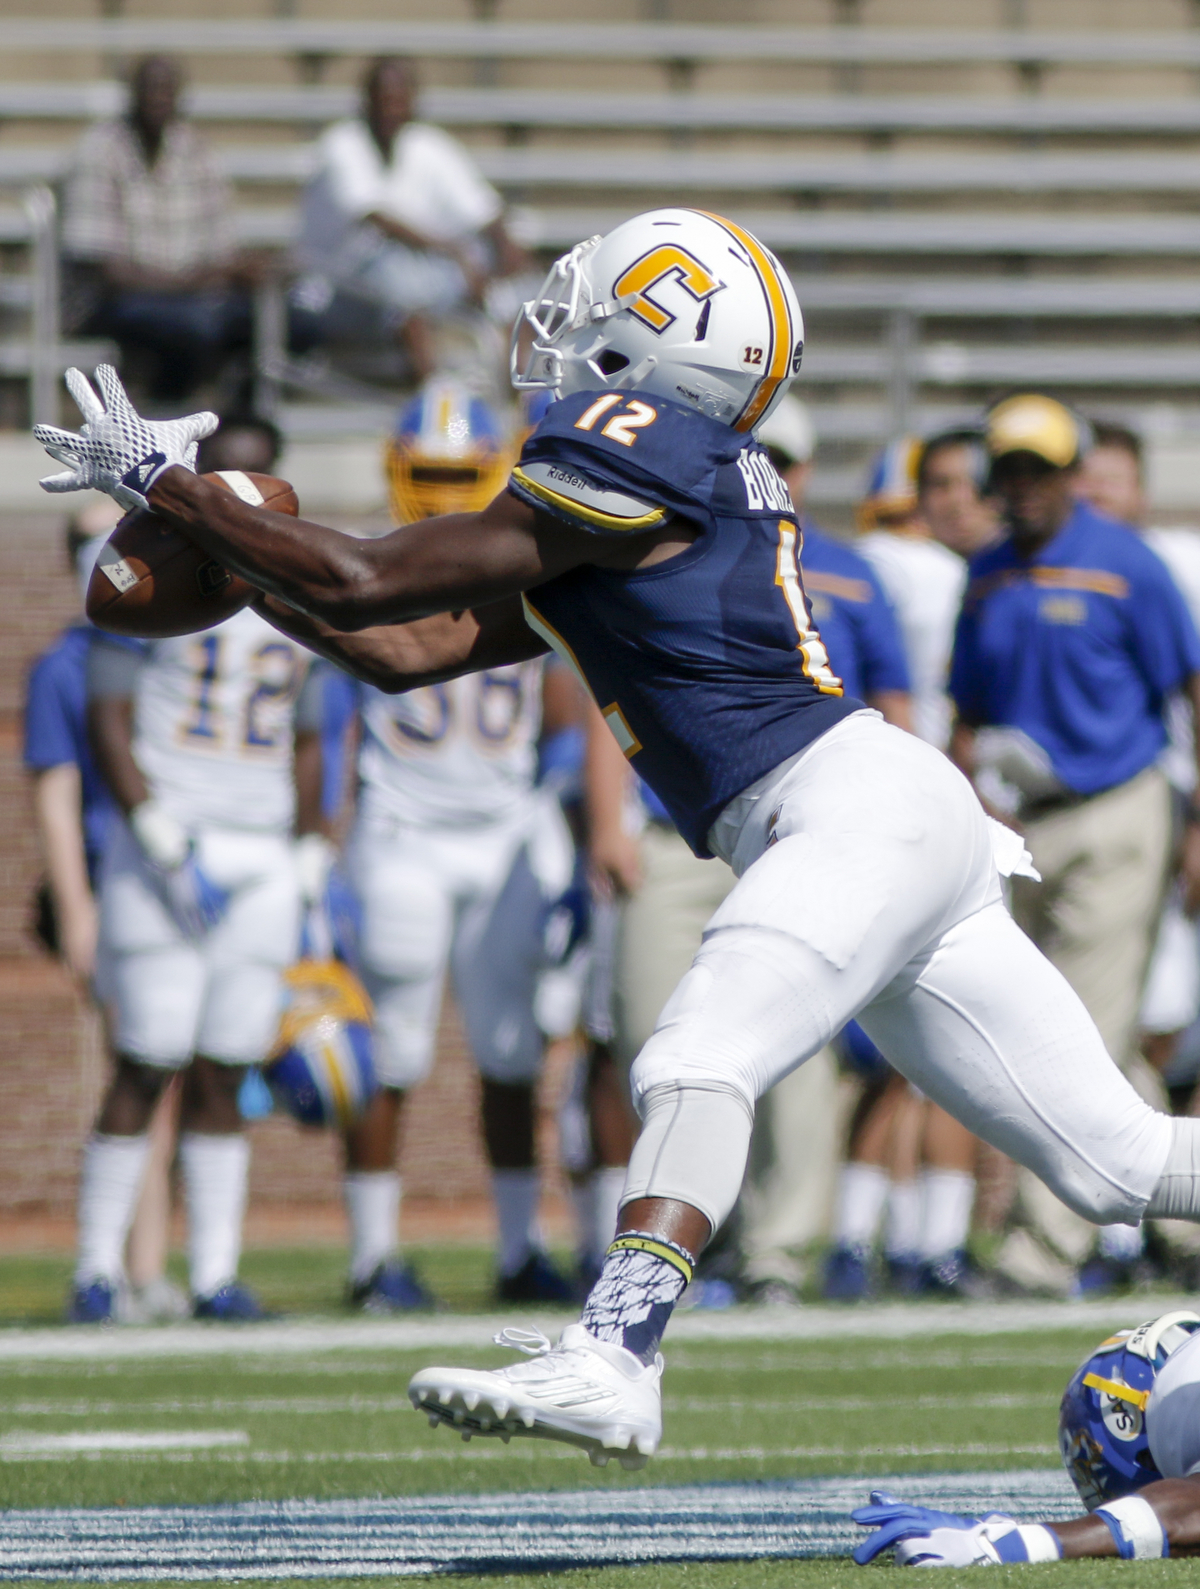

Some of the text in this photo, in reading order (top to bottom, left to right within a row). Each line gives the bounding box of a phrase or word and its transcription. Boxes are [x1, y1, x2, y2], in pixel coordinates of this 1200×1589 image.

[743, 346, 763, 365] 12
[574, 393, 656, 447] 12
[547, 465, 587, 490] Riddell
[774, 519, 845, 697] 1
[177, 634, 297, 758] 12
